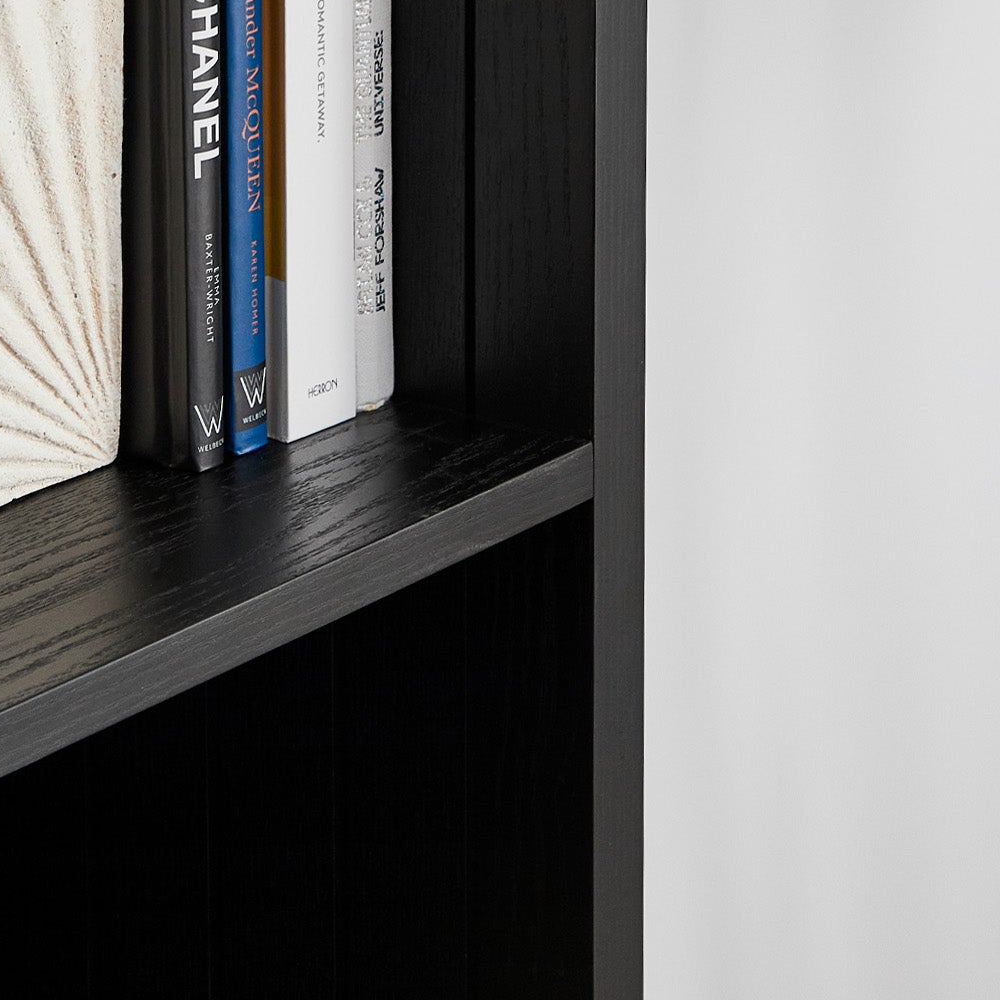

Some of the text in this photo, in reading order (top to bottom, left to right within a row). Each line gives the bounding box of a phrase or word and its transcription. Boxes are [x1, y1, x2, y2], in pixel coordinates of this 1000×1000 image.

[317, 70, 326, 144] GETAWAY.
[374, 29, 384, 137] UNIVERSE:
[241, 66, 261, 213] McQUEEN
[205, 233, 215, 343] BAXTER-WRIGHT
[250, 240, 259, 336] KAREN HOMER
[374, 167, 386, 312] JEFF FORSHAW
[307, 377, 338, 399] HERRON
